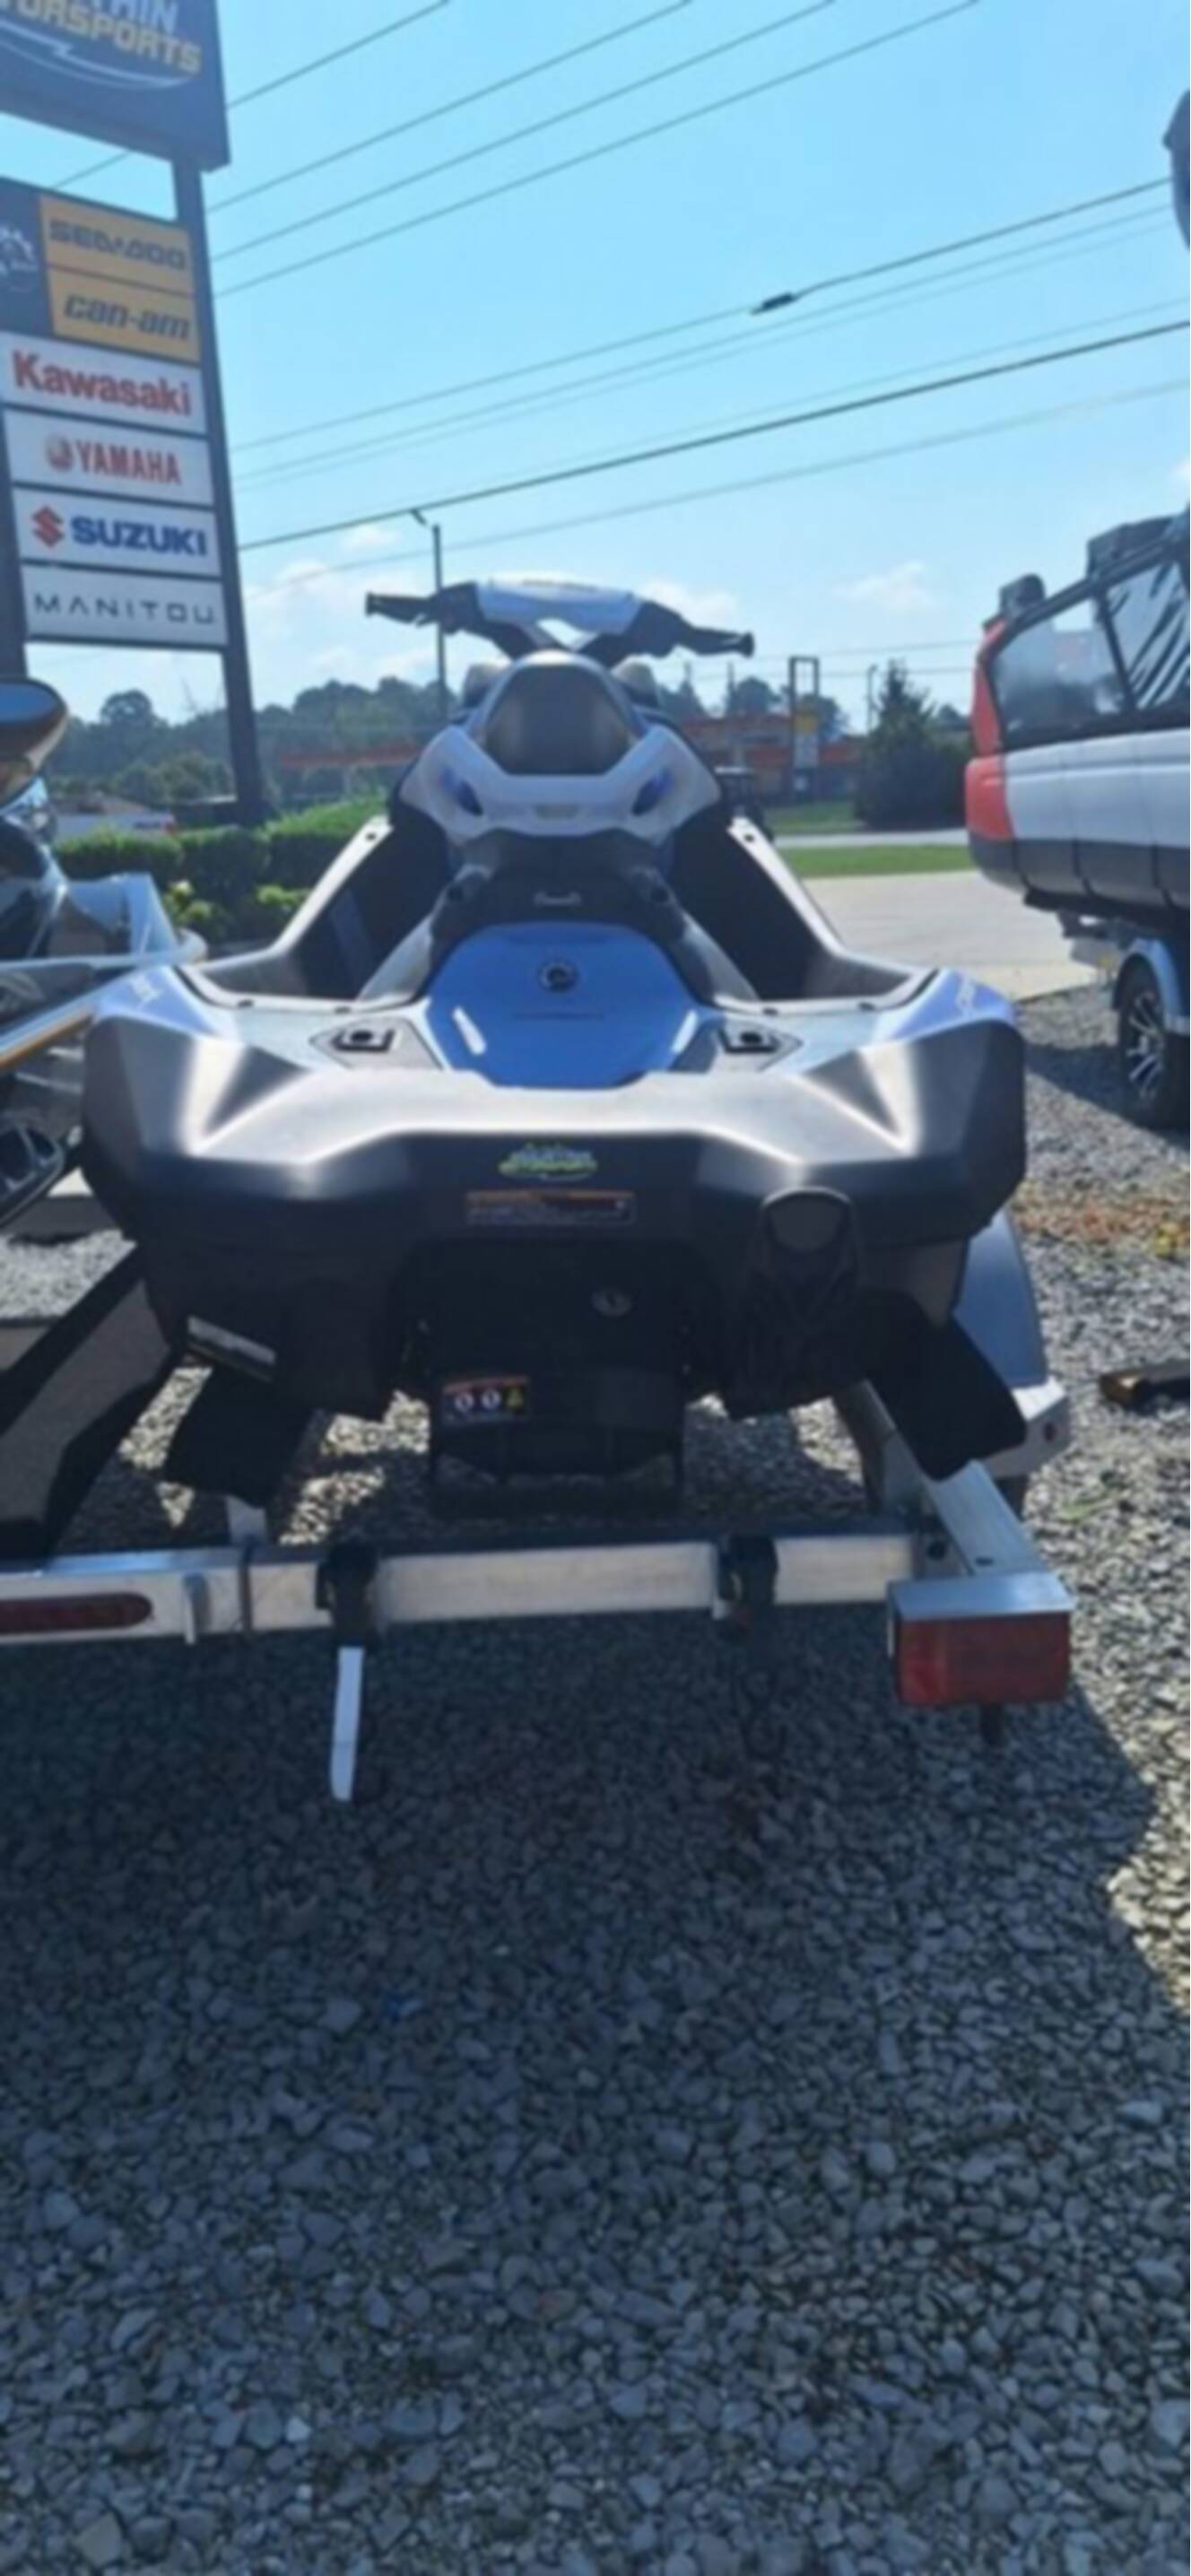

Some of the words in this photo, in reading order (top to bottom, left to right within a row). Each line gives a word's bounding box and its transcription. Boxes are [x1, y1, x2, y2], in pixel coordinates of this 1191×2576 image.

[91, 0, 178, 37] AIN
[12, 349, 192, 417] Kawasaki
[74, 439, 183, 485] YAMAHA
[70, 515, 208, 557] SUZUKI
[33, 593, 214, 625] MANITOU
